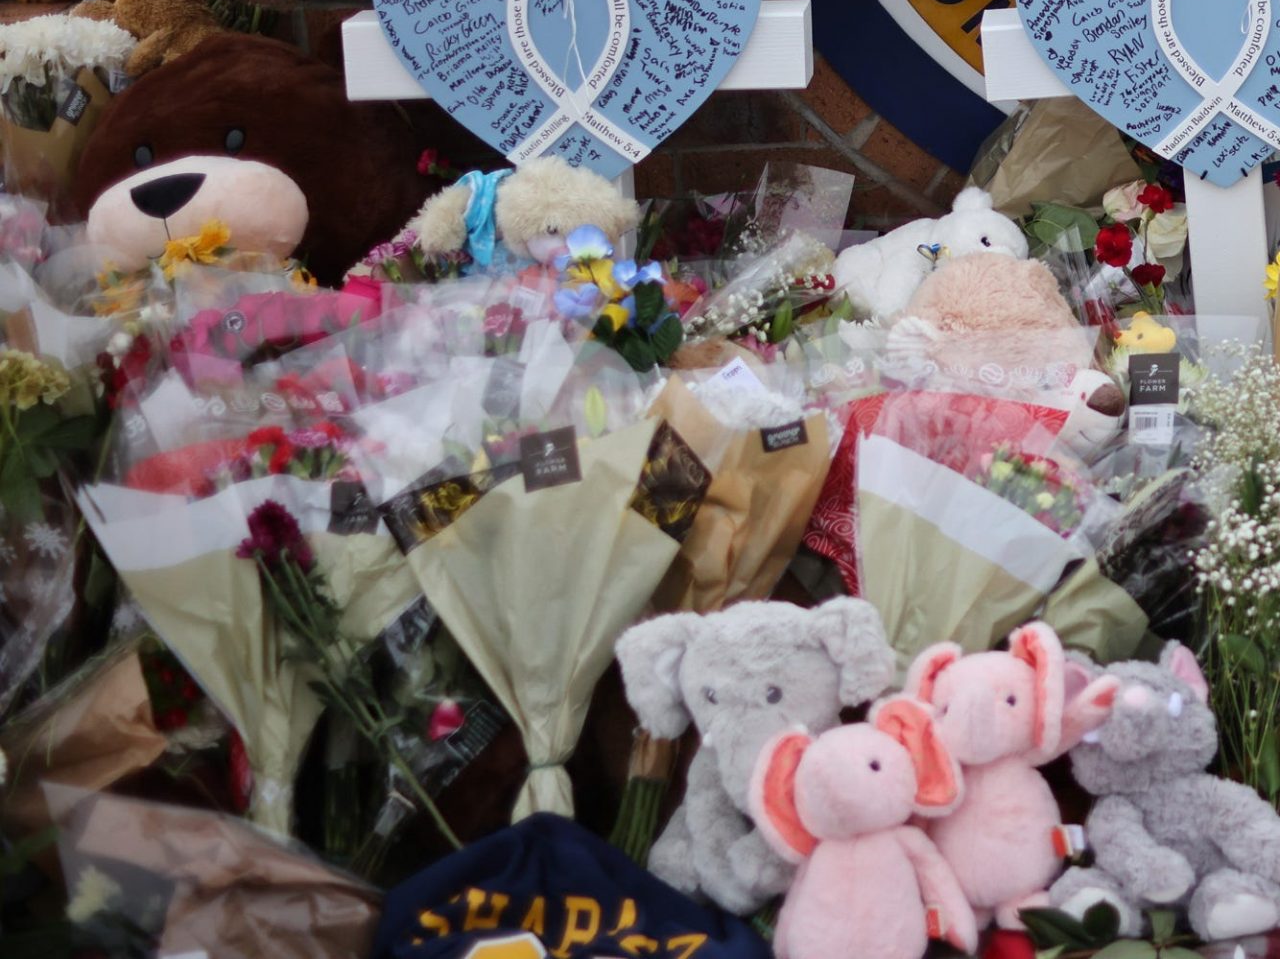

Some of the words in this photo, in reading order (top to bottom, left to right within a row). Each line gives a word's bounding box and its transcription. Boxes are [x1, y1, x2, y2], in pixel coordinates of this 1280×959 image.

[513, 5, 525, 38] those
[614, 12, 625, 28] be
[1257, 0, 1268, 15] be
[520, 39, 534, 59] are
[1163, 30, 1177, 50] are
[1232, 16, 1266, 77] comforted.
[528, 60, 565, 98] Blessed
[1174, 50, 1205, 87] Blessed
[582, 111, 624, 146] Matthew
[624, 141, 641, 158] 5:4
[1161, 124, 1194, 155] Madisyn
[1191, 96, 1223, 127] Baldwin
[1226, 102, 1269, 133] Matthew
[519, 135, 544, 161] Justin
[541, 114, 570, 141] Shilling
